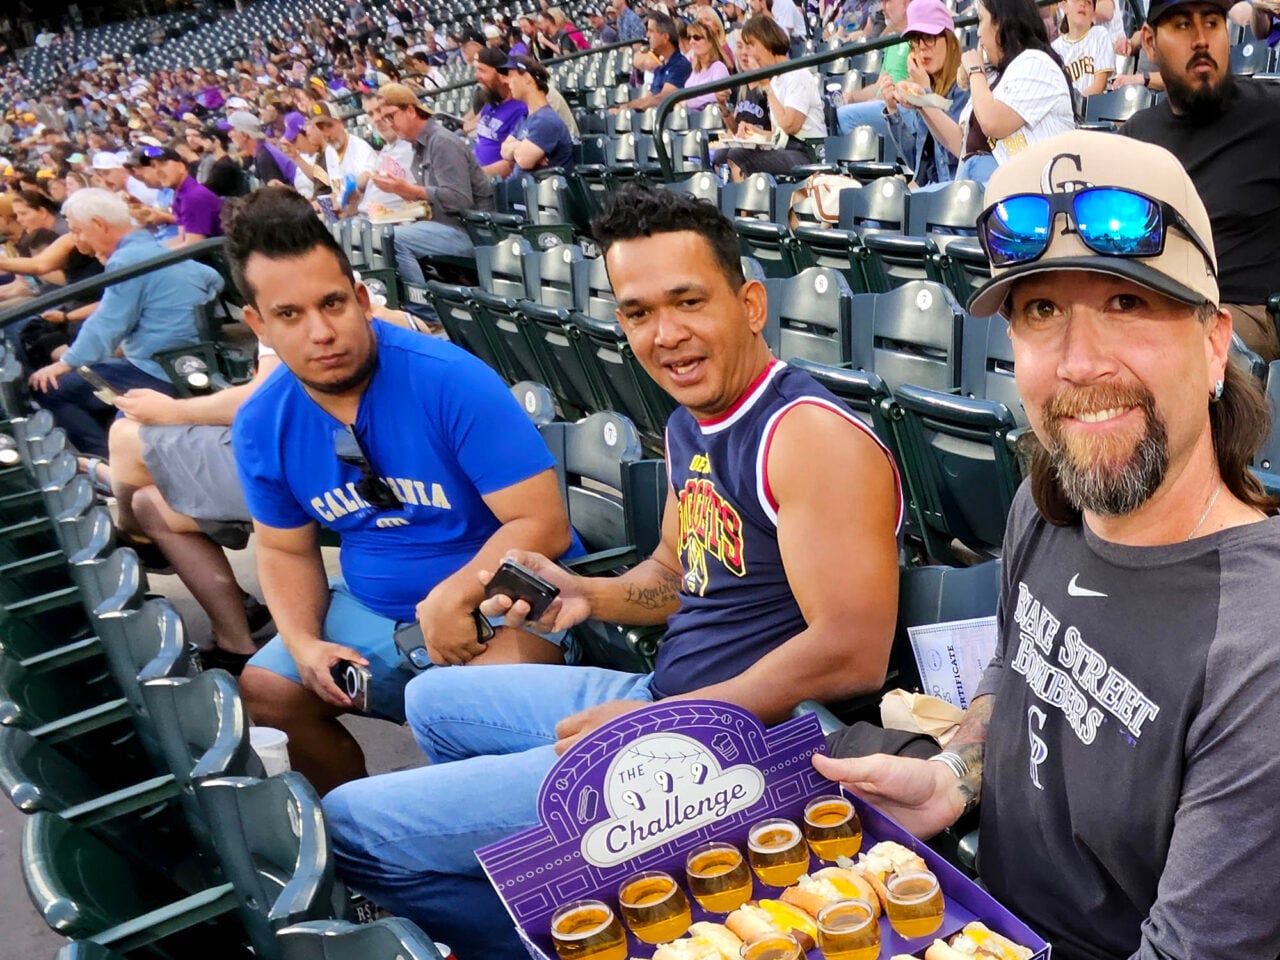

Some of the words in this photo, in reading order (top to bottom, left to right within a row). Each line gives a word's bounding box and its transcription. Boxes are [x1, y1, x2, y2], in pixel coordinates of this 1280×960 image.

[946, 645, 968, 711] ERTIFICATE
[1058, 626, 1160, 737] STREET
[618, 764, 645, 783] THE
[605, 783, 747, 853] Challenge
